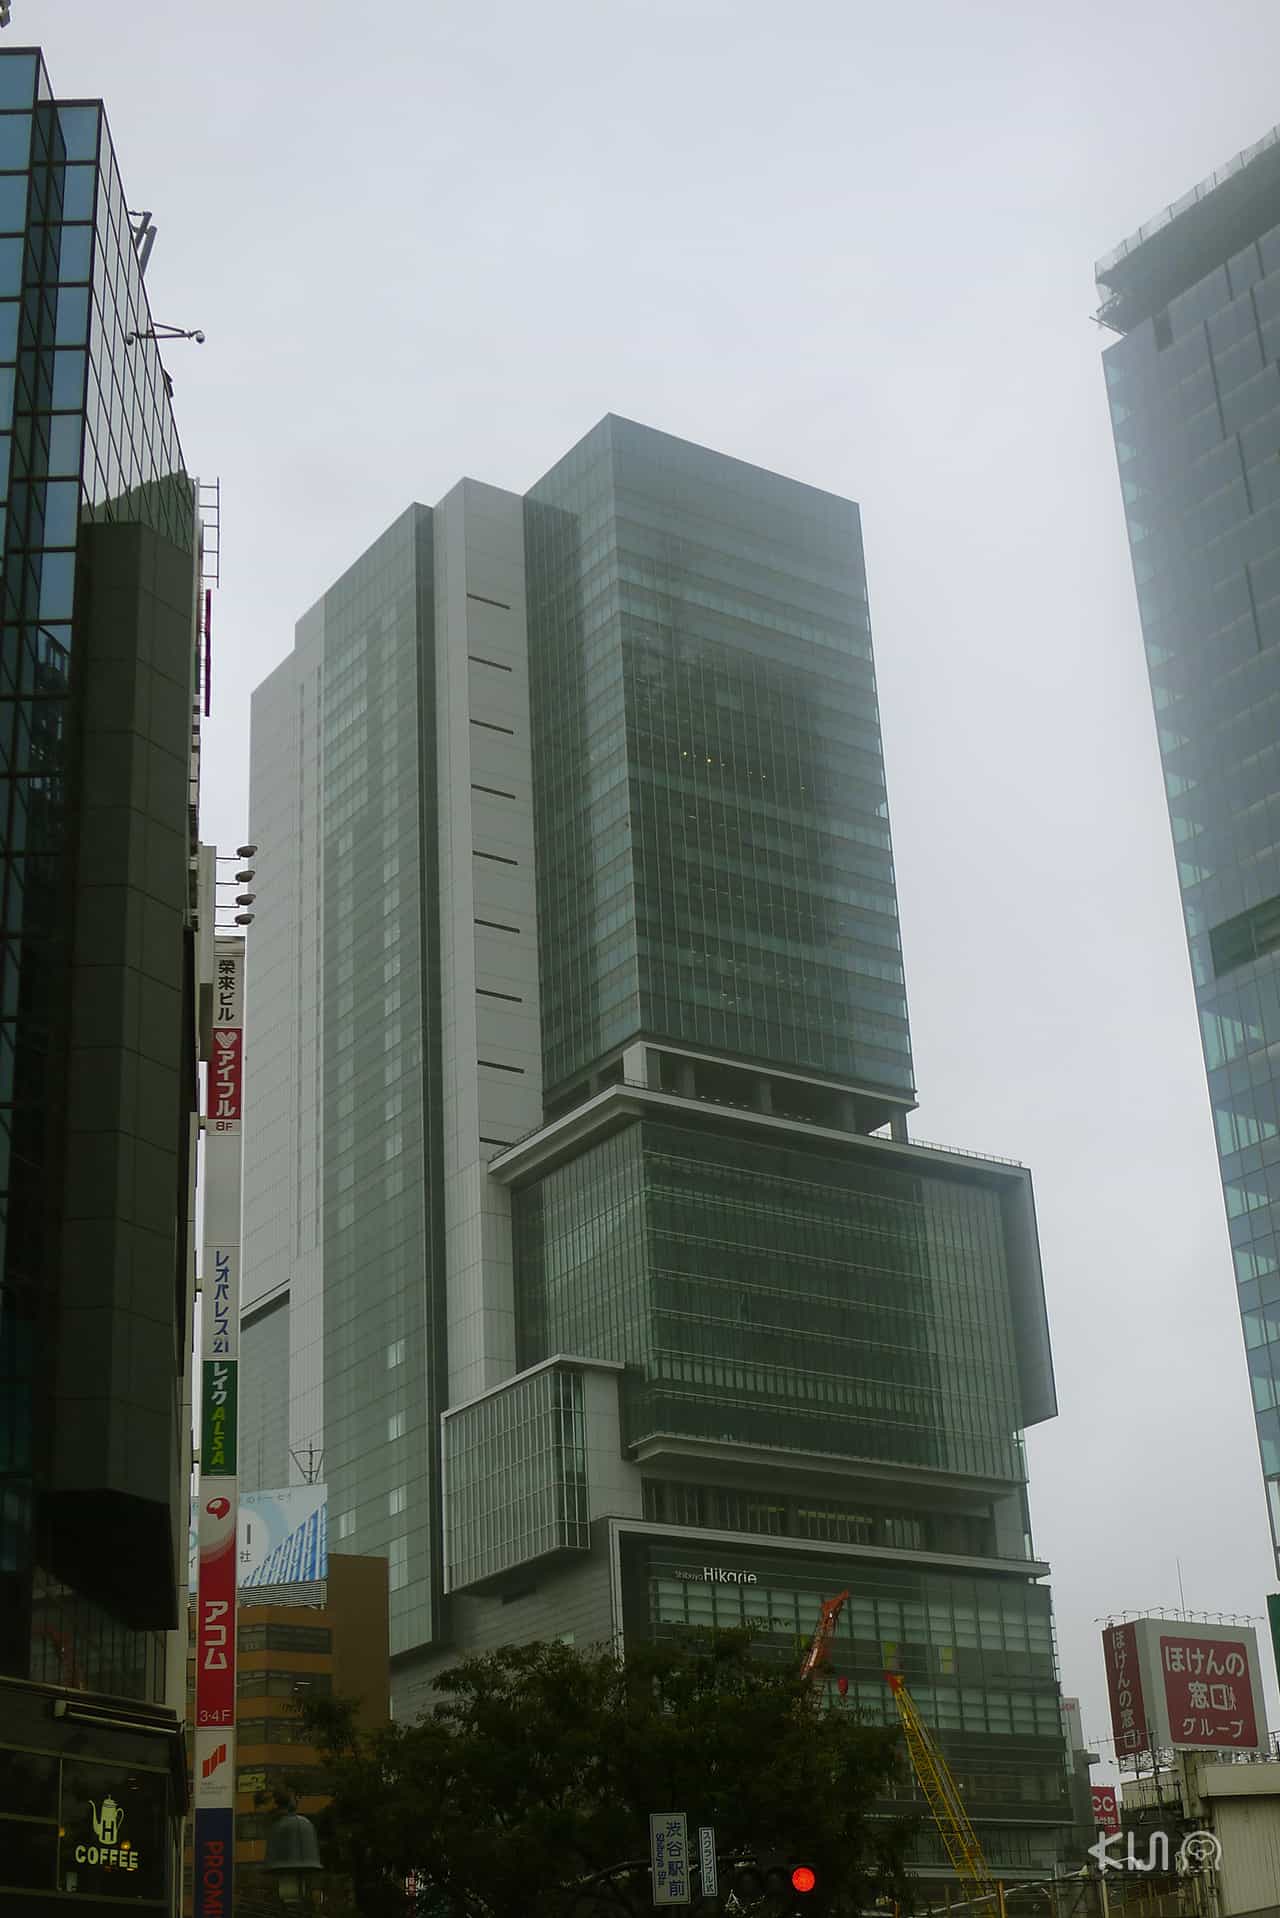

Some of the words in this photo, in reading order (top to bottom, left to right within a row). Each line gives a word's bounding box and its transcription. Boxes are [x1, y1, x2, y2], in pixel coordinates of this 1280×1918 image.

[215, 1050, 236, 1117] アイフル
[215, 1121, 233, 1132] 8F
[213, 1250, 230, 1353] レオパレス21
[703, 1566, 758, 1585] Hikarie
[204, 1600, 229, 1670] アコム
[1164, 1645, 1246, 1678] ほけんの
[1111, 1630, 1140, 1749] ほけんの窓口
[1187, 1680, 1237, 1711] 窓口
[1181, 1716, 1246, 1739] グループ
[75, 1844, 139, 1869] COFFEE
